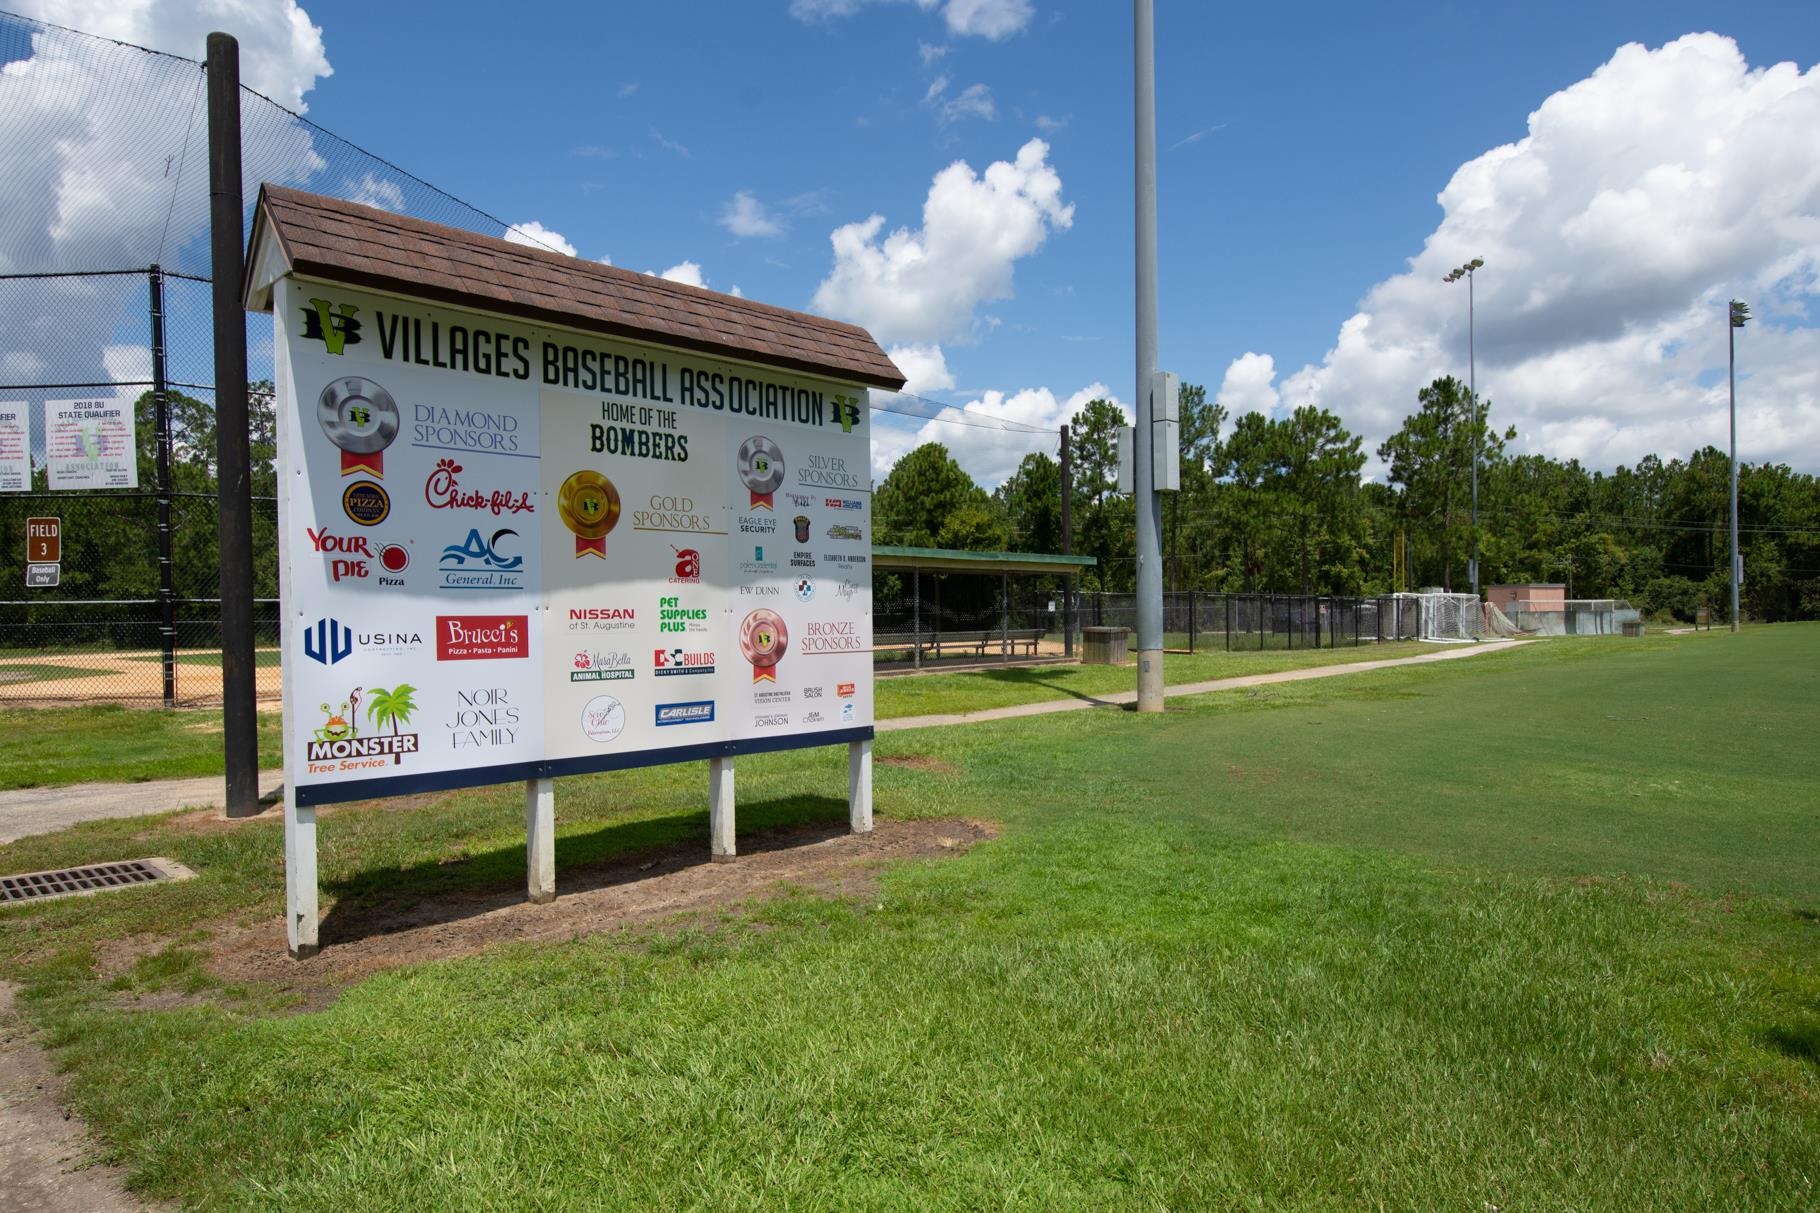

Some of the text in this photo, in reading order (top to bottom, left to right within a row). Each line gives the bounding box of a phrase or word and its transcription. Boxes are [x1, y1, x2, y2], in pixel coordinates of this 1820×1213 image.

[376, 311, 530, 380] VILLAGES
[542, 341, 673, 403] BASEBALL
[680, 366, 823, 426] ASSOCIATION
[58, 410, 120, 419] STATE QUALIFIER
[414, 404, 518, 432] DIAMOND
[602, 401, 677, 430] HOME OF THE
[414, 425, 518, 451] SPONSORS
[590, 423, 689, 462] BOMBERS
[808, 454, 847, 472] SILVER
[798, 468, 858, 487] SPONSORS
[425, 463, 534, 515] Chick-fil-A
[350, 498, 384, 508] PIZZA
[650, 495, 693, 512] GOLD
[633, 511, 710, 530] SPONSORS
[738, 516, 777, 527] EAGLE EYE
[30, 524, 58, 537] FIELD
[740, 526, 776, 534] SECURITY
[307, 527, 374, 558] YOUR
[440, 529, 523, 569] AC
[41, 543, 47, 556] 3
[793, 551, 812, 559] EMPIRE
[790, 559, 815, 567] SURFACES
[32, 566, 56, 574] Baseball
[36, 575, 50, 583] Only
[379, 577, 405, 586] Pizza
[499, 574, 517, 585] Inc
[741, 586, 779, 595] EW DUNN
[660, 597, 679, 608] PET
[570, 608, 634, 620] NISSAN
[660, 609, 707, 620] SUPPLIES
[447, 620, 518, 645] Brucci's
[569, 622, 578, 630] of
[593, 622, 635, 631] Augustine
[660, 621, 686, 632] PLUS
[807, 622, 855, 636] BRONZE
[358, 633, 422, 645] USINA
[802, 636, 861, 651] SPONSORS
[449, 647, 467, 655] Pizza
[684, 652, 715, 666] BUILDS
[573, 670, 633, 680] ANIMAL HOSPITAL
[458, 688, 508, 707] NOIR
[446, 708, 520, 728] JONES
[659, 705, 713, 720] CARLISLE
[754, 717, 789, 727] JOHNSON
[452, 727, 520, 749] FAMILY
[309, 735, 417, 760] MONSTER
[308, 759, 385, 774] Tree Service
